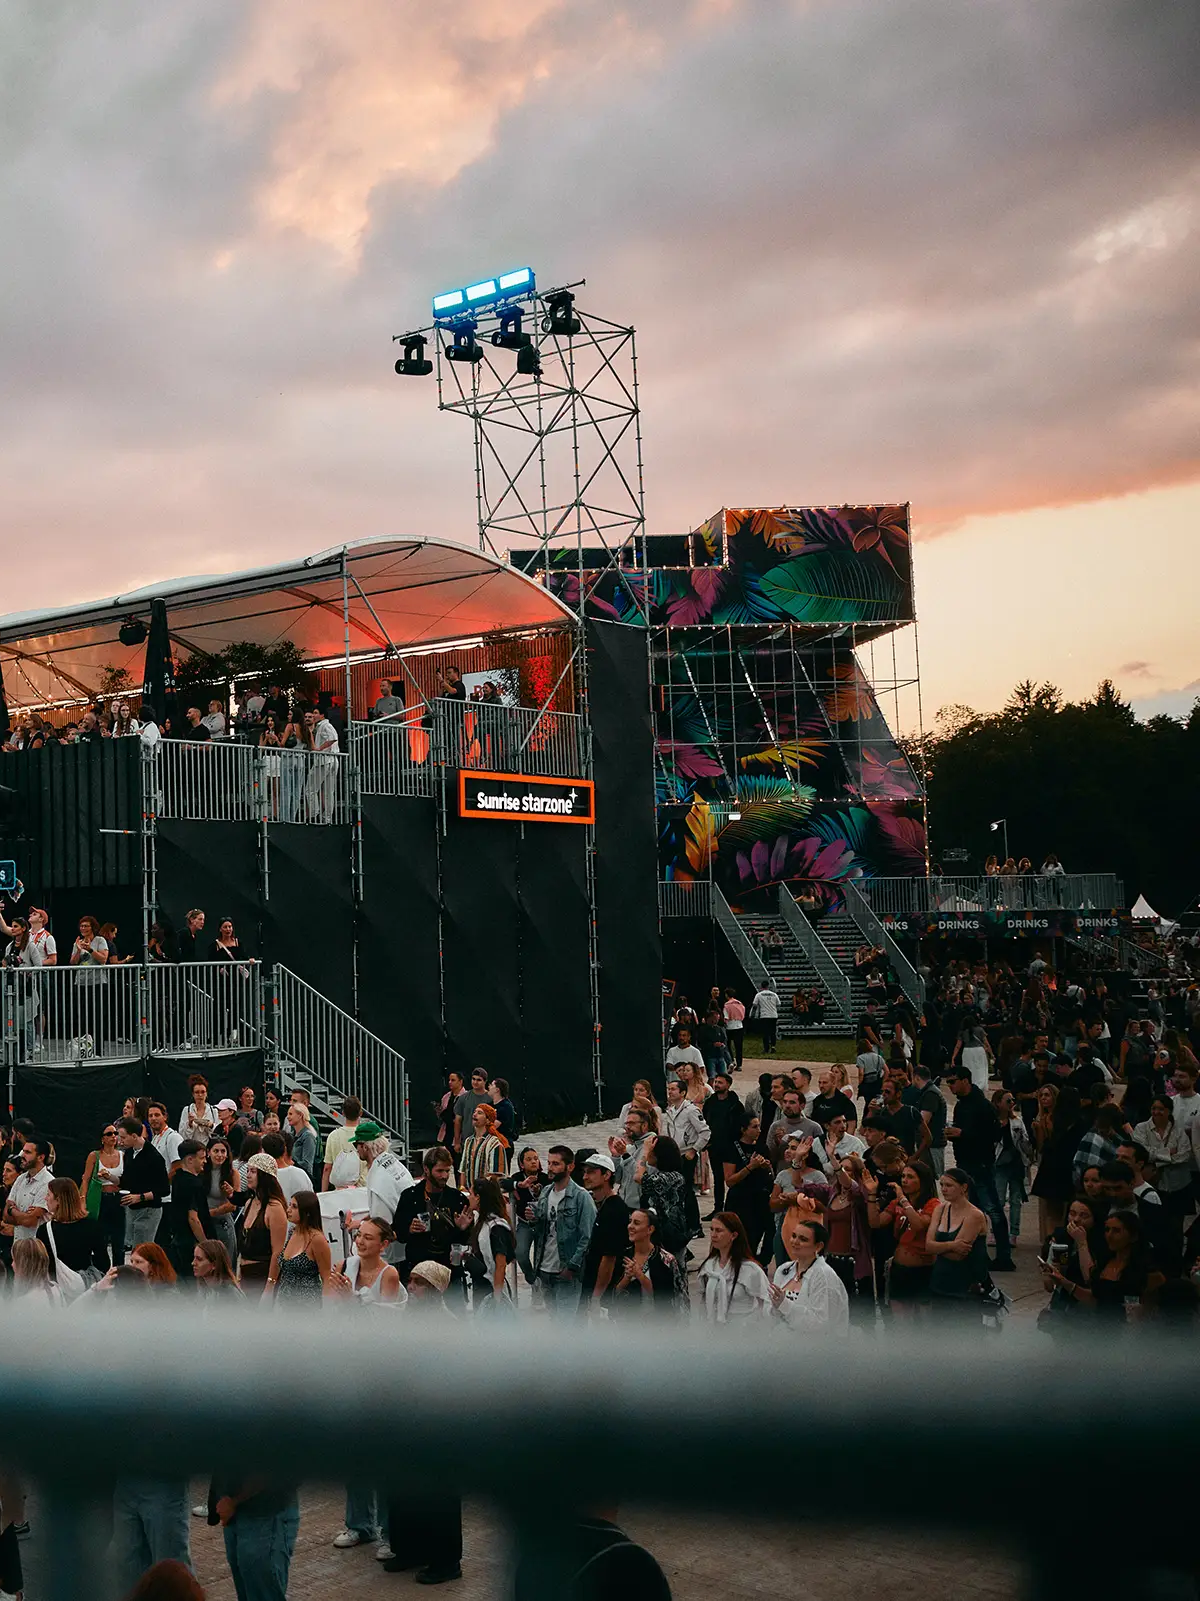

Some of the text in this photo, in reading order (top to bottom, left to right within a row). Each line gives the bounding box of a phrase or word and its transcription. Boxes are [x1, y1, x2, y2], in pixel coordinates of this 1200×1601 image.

[477, 791, 573, 814] Sunrise starzone
[868, 921, 909, 931] DINKS
[938, 920, 980, 930] DRINKS
[1007, 919, 1049, 929] DRINKS
[1076, 918, 1119, 927] DRINKS
